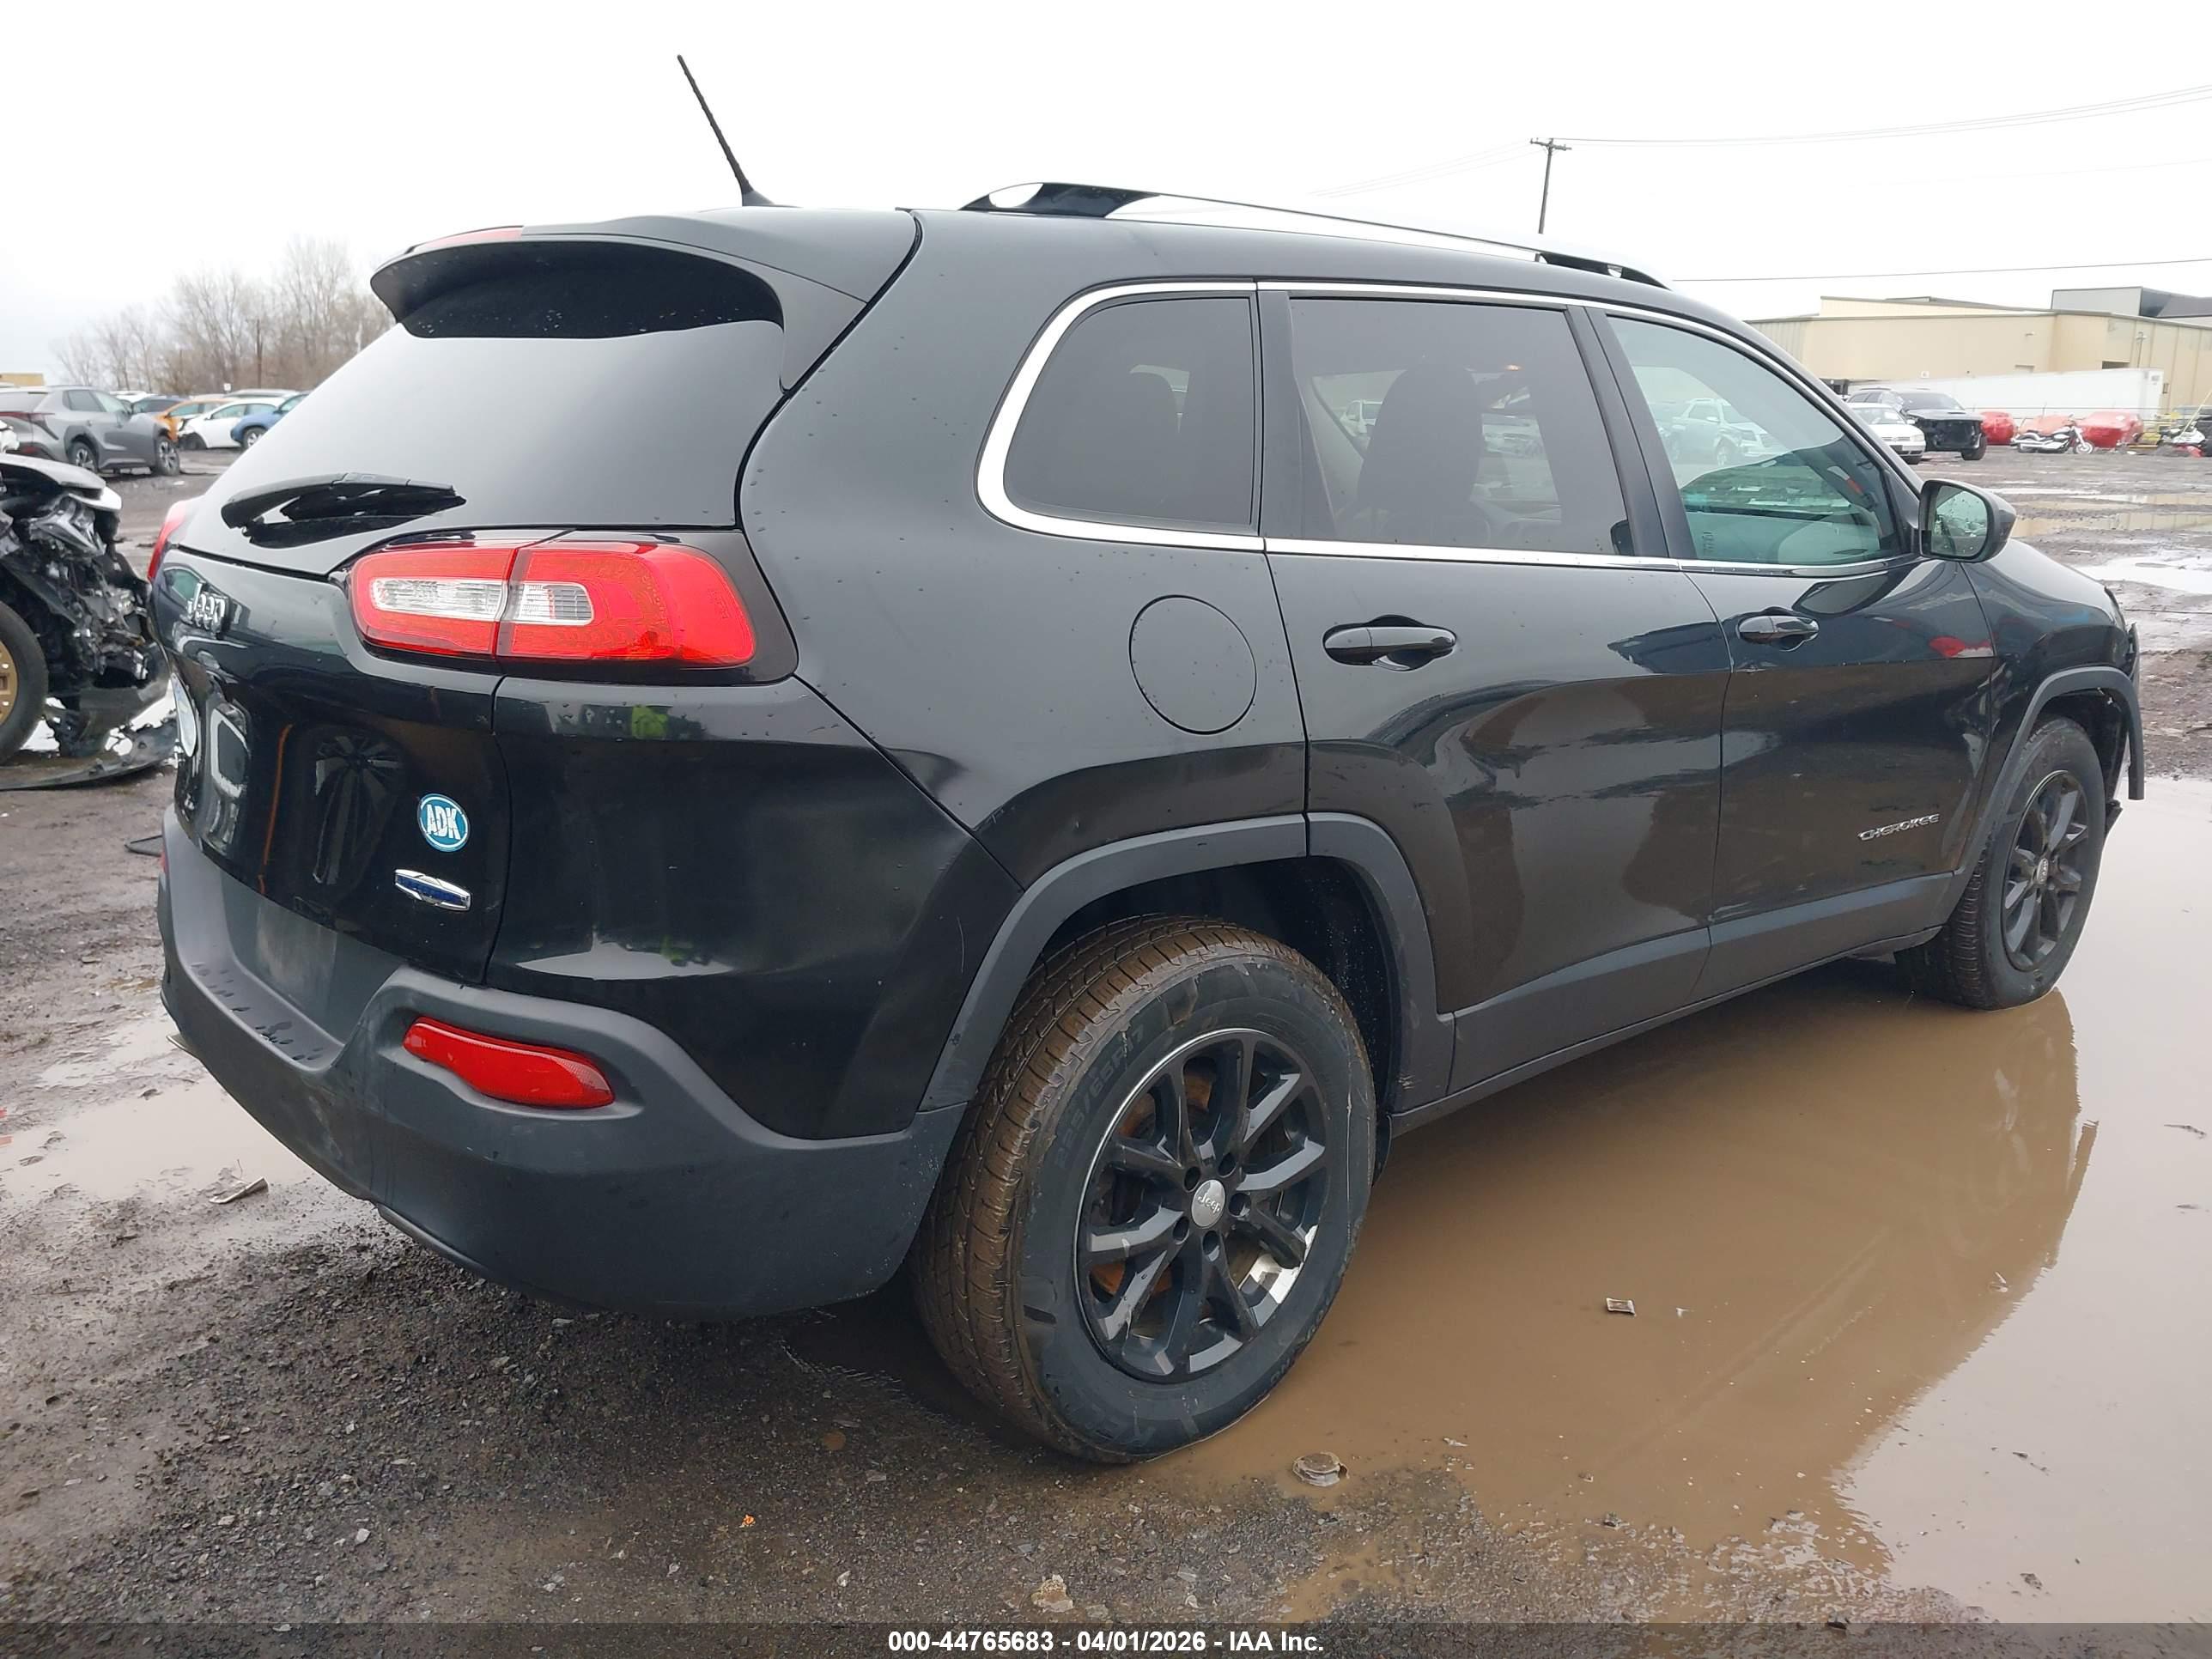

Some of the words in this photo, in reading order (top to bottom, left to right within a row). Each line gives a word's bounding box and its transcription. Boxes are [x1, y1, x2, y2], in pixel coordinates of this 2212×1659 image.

[181, 583, 225, 632] Jeep
[426, 804, 461, 841] ADK
[1857, 813, 1941, 841] CHEROKEE
[1197, 1192, 1220, 1213] Jeep
